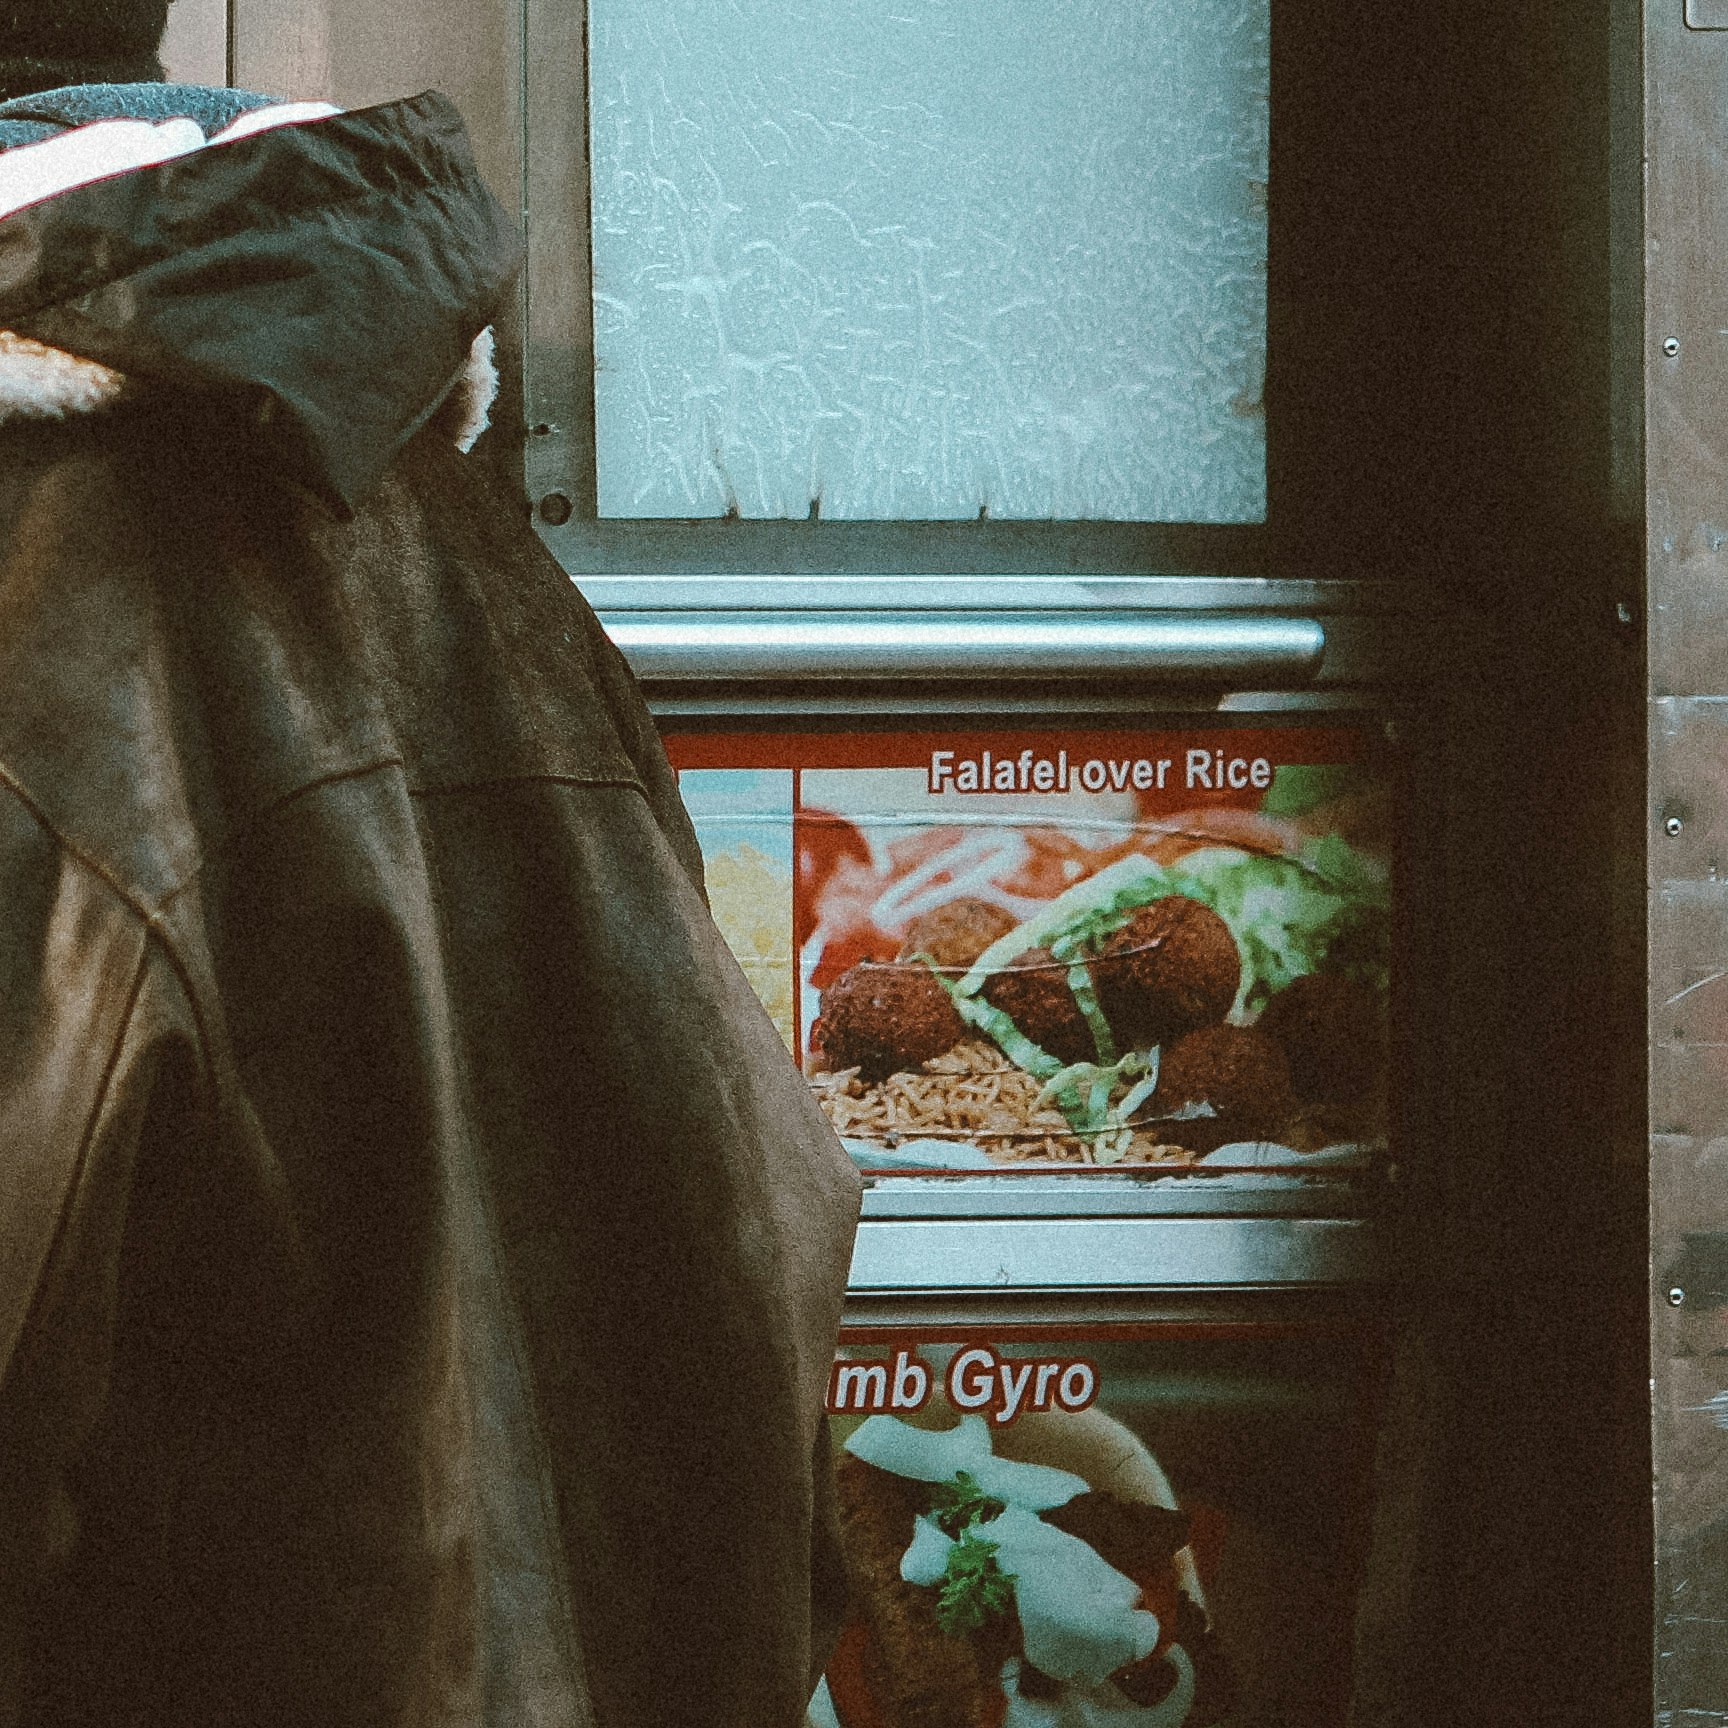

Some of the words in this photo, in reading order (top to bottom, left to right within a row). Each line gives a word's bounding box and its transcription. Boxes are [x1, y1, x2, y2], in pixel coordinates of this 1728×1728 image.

[928, 748, 1069, 793] Falafel
[1080, 756, 1172, 792] over
[1184, 747, 1273, 790] Rice
[825, 1350, 929, 1411] mb
[949, 1348, 1096, 1425] Gyro
